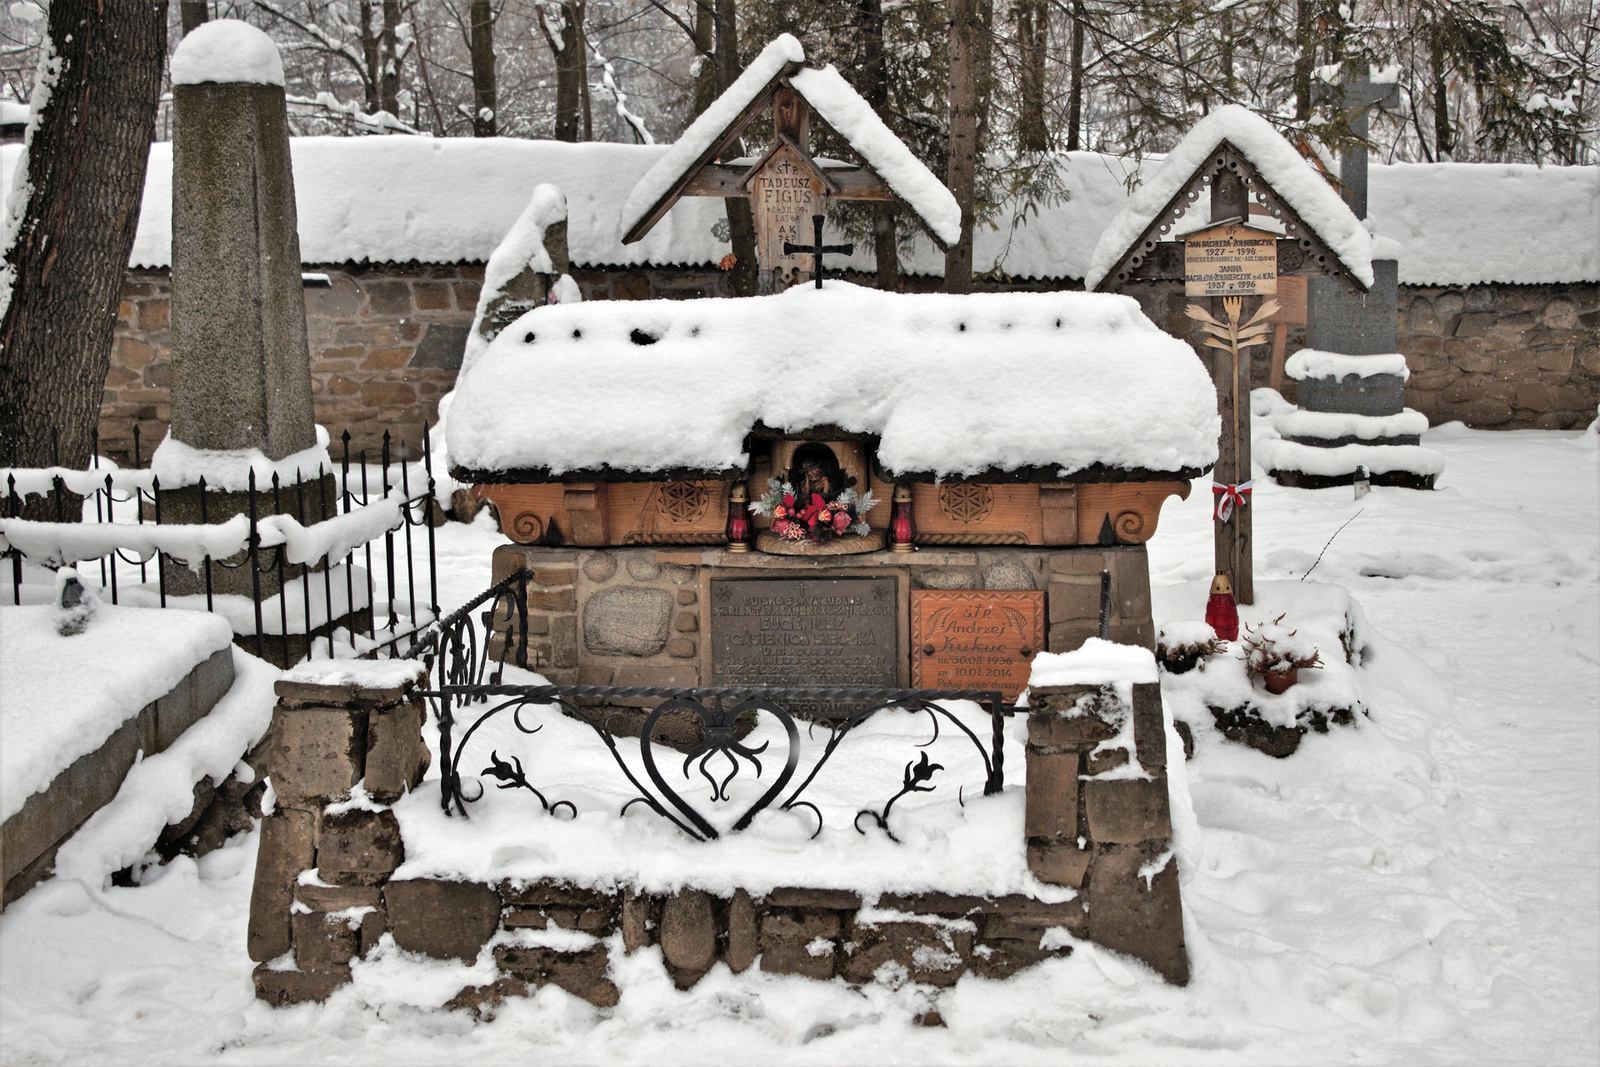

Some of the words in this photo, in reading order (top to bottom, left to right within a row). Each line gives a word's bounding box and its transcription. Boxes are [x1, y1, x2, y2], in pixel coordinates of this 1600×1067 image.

[760, 177, 811, 189] TADEUSZ
[764, 189, 811, 204] FIGUS
[1187, 240, 1201, 248] JAN
[1205, 248, 1226, 256] 1927
[1219, 265, 1243, 273] JANINA
[1207, 282, 1226, 290] 1937
[760, 617, 845, 632] EUGENIUSZ
[944, 620, 1007, 638] Andrzej
[813, 630, 877, 646] SIECZKA
[940, 636, 1008, 654] Kukuc
[937, 657, 949, 665] ur.
[955, 667, 1012, 678] 10.01.2014
[936, 678, 962, 690] Pokój
[966, 680, 988, 690] jego
[990, 679, 1020, 692] duszy
